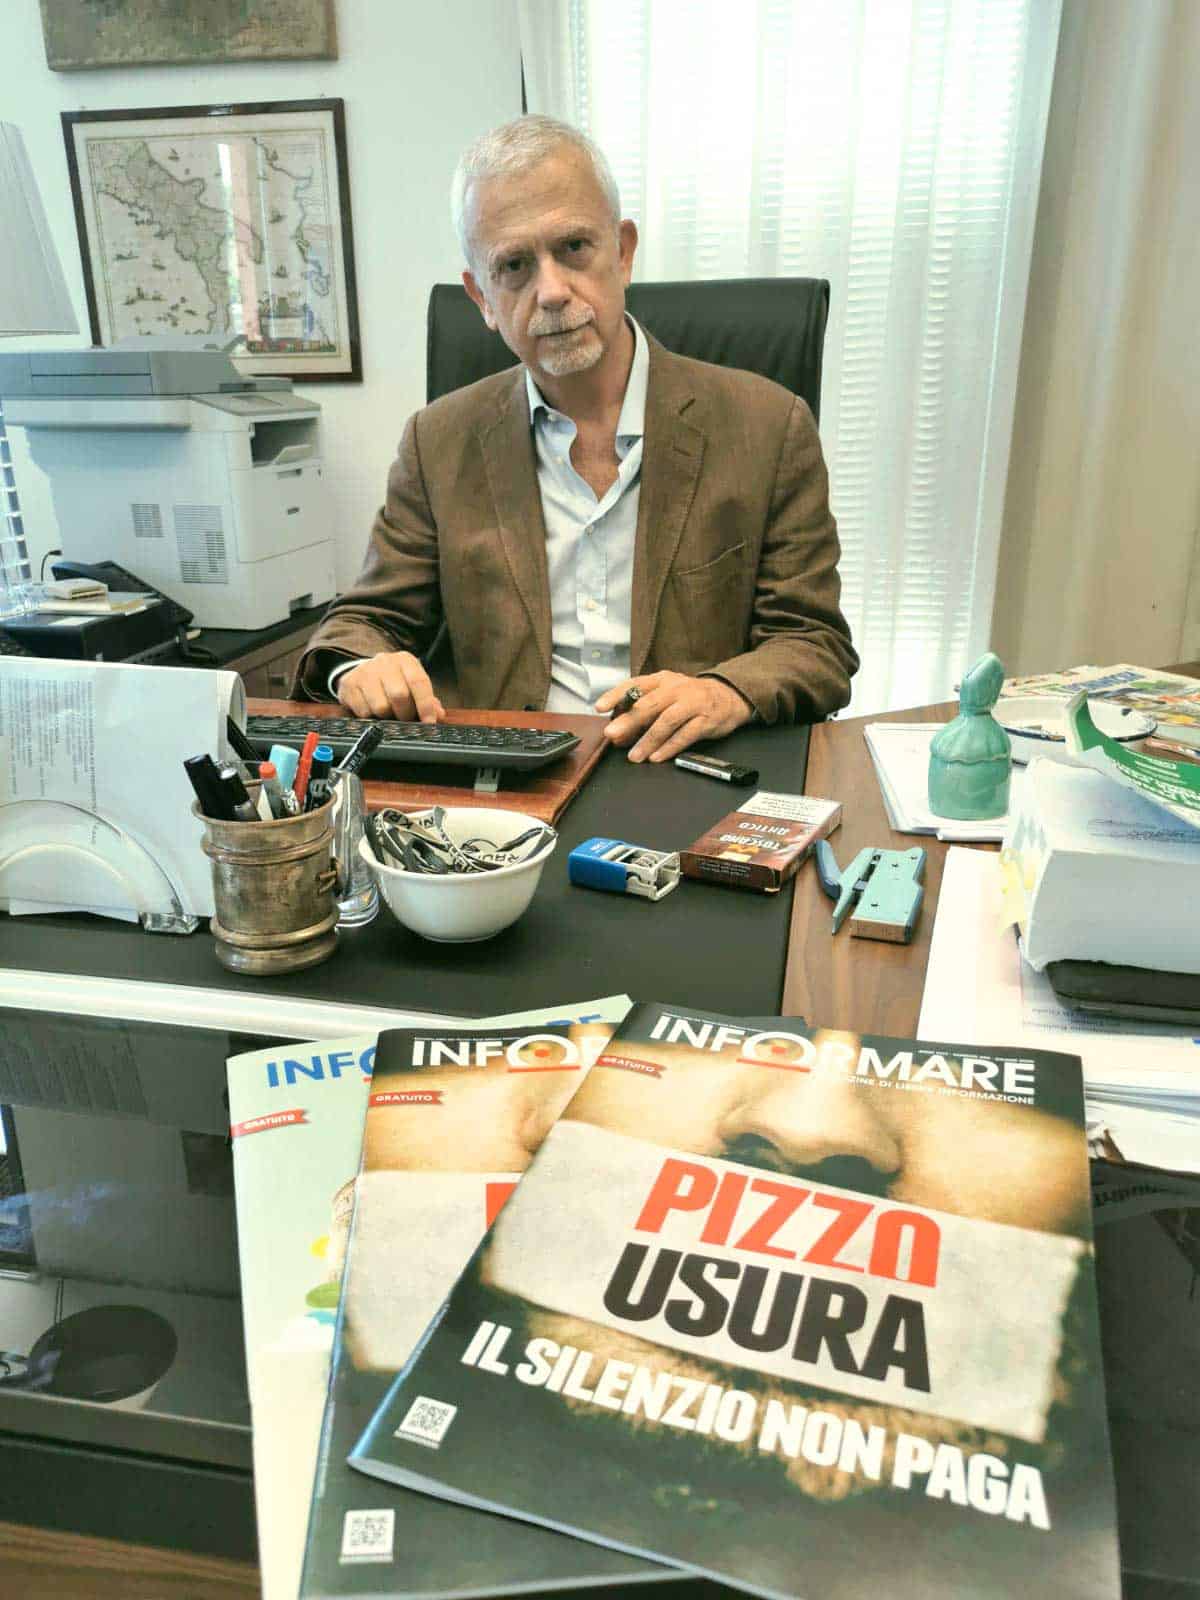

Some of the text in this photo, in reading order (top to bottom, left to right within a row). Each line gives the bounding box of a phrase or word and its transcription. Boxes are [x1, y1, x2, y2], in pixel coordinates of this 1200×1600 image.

[266, 1046, 377, 1088] INF
[649, 1015, 1035, 1095] INFORMARE
[243, 1113, 295, 1130] GRATUITO
[375, 1093, 433, 1103] GRATUITO
[634, 1157, 941, 1288] PIZZO
[603, 1242, 932, 1393] USURA
[460, 1321, 514, 1376] IL
[515, 1337, 757, 1443] SILENZIO
[758, 1399, 888, 1481] NON
[892, 1432, 1052, 1530] PAGA
